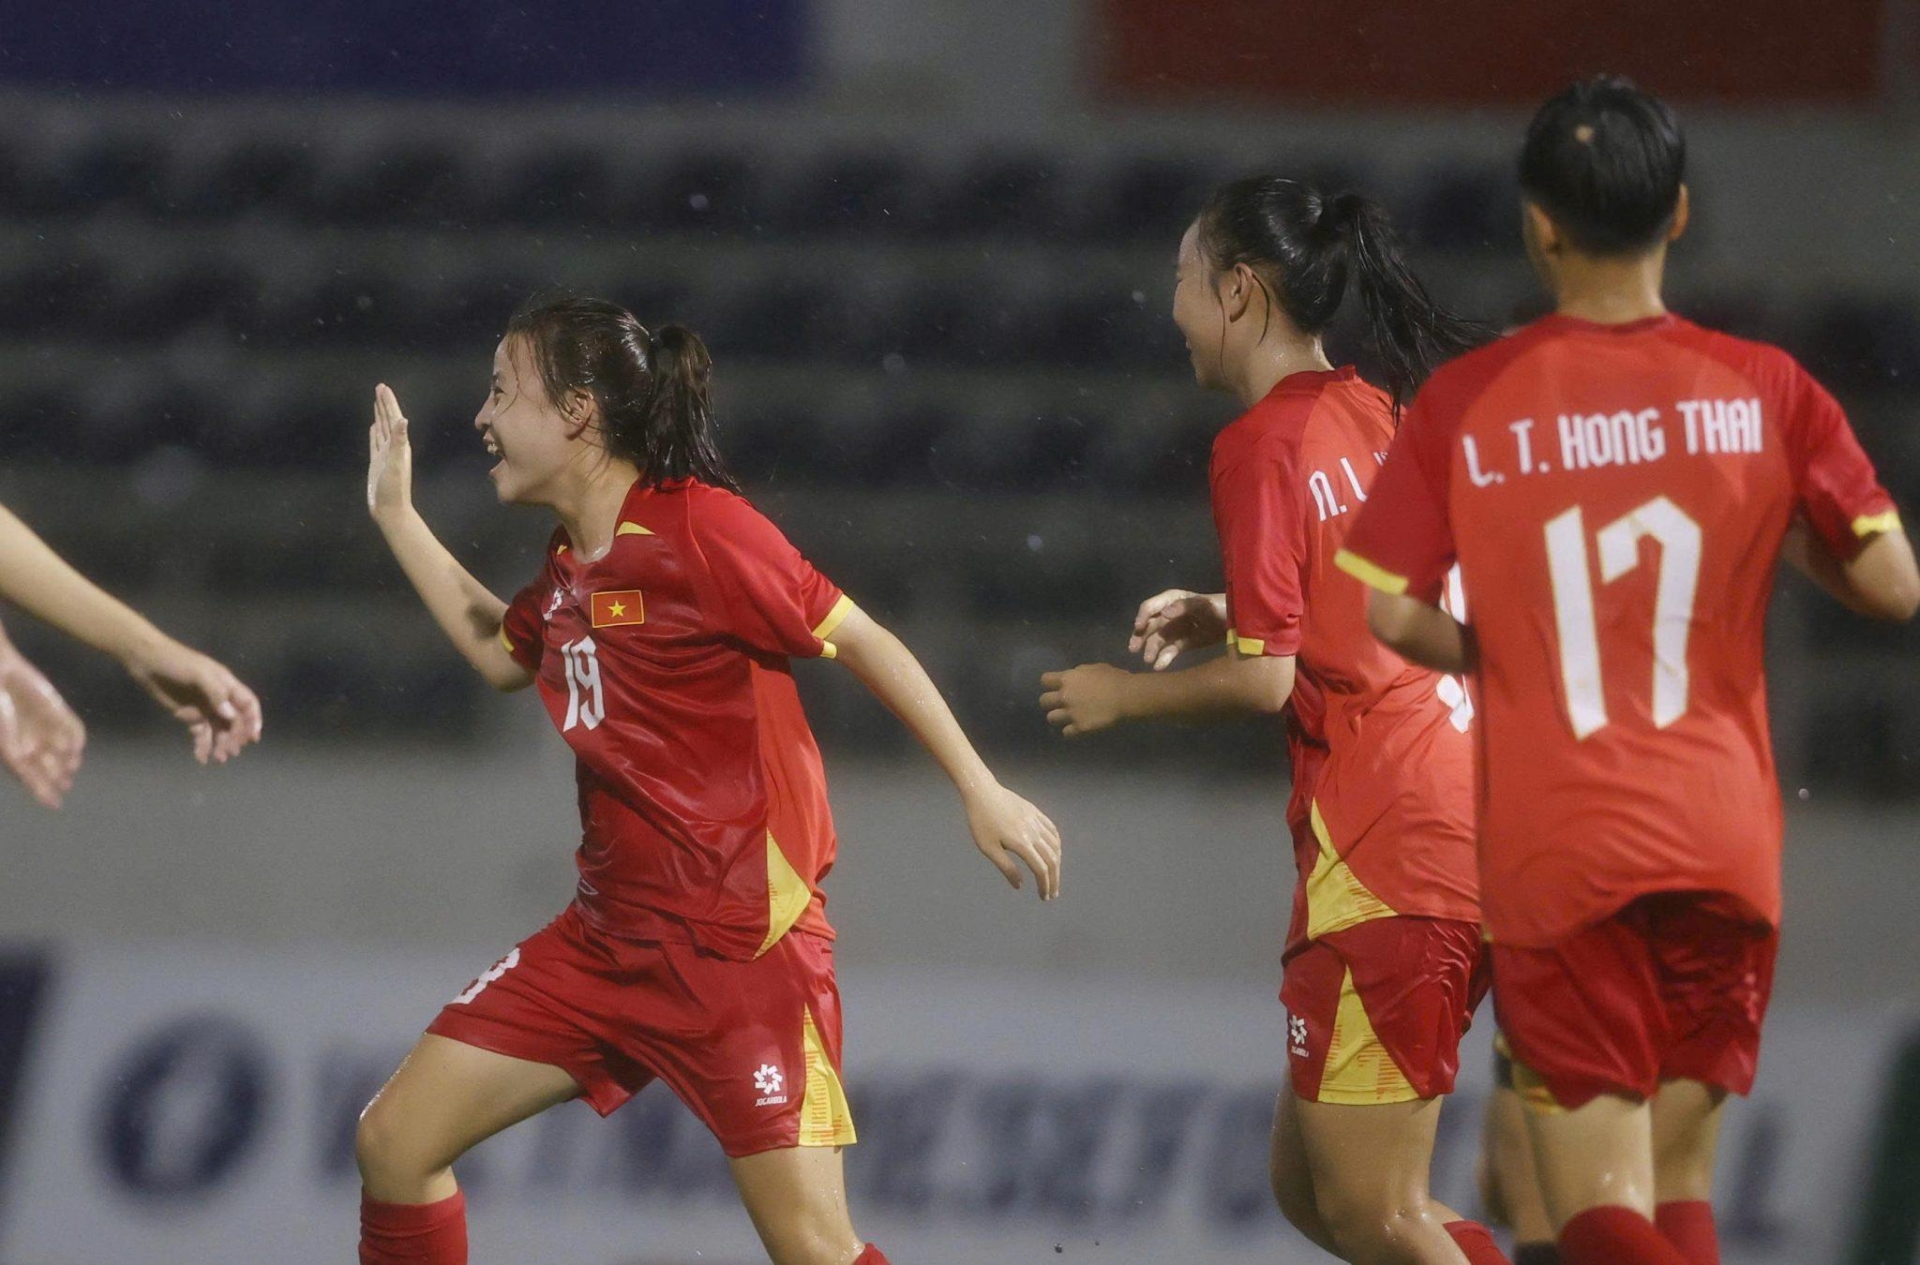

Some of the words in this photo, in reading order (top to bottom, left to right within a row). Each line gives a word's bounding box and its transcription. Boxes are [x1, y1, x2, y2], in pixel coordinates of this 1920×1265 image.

[1462, 434, 1505, 487] L.
[1508, 418, 1550, 474] T.
[1557, 406, 1666, 471] HONG
[1676, 398, 1762, 455] THAI
[1544, 495, 1701, 742] 17
[561, 635, 605, 732] 19
